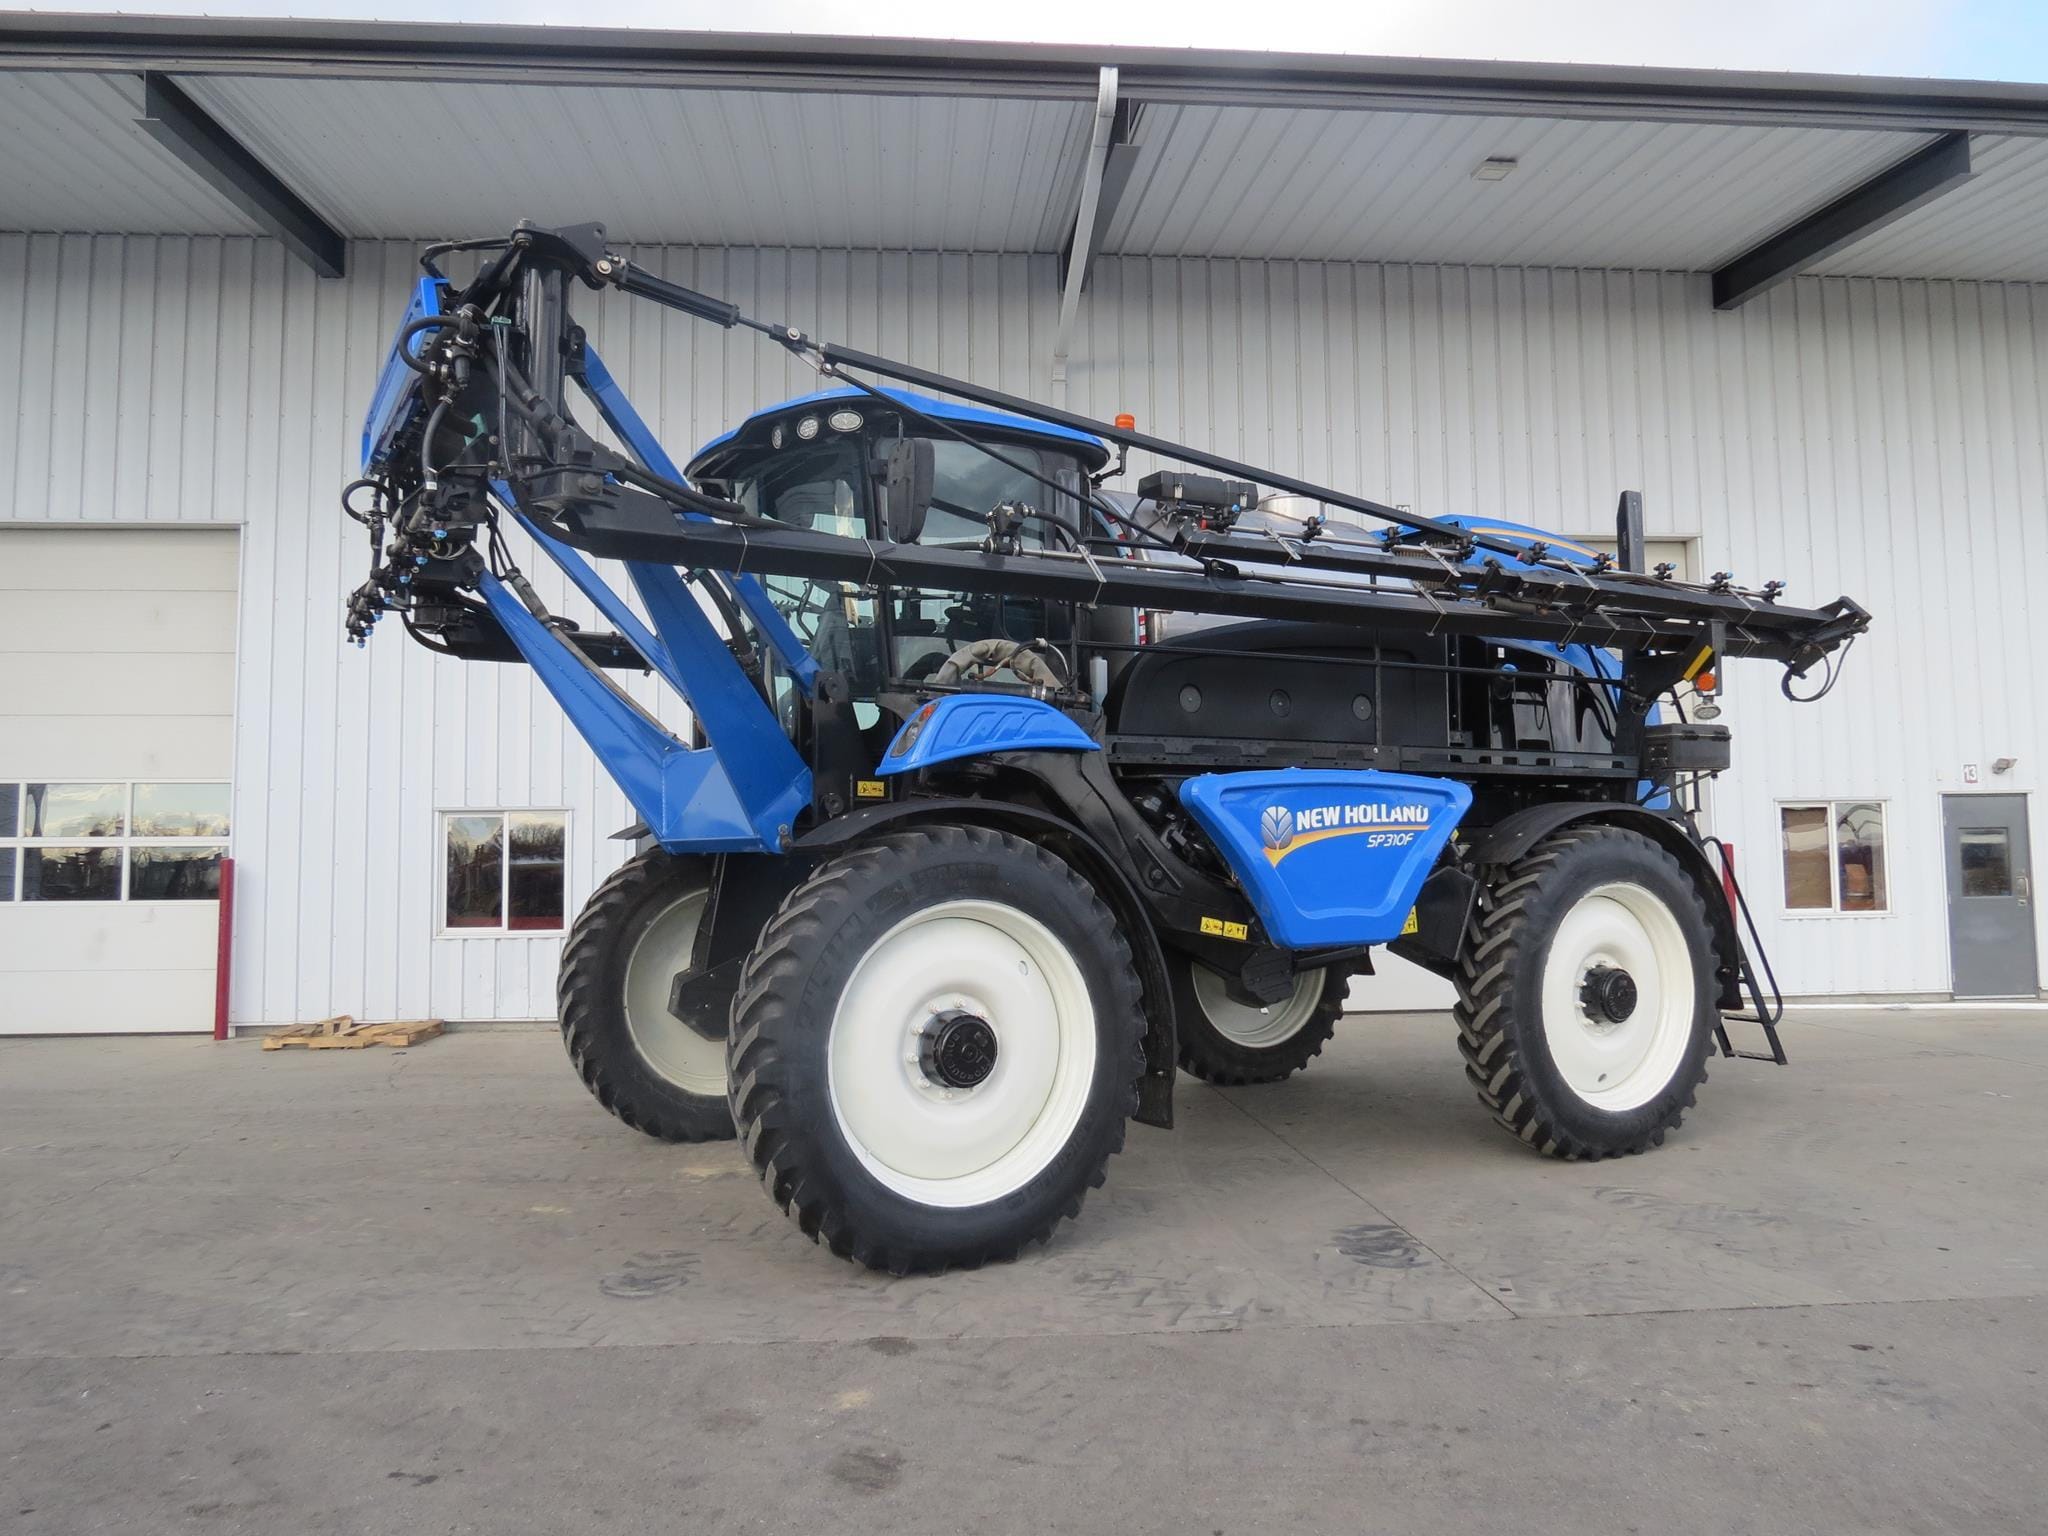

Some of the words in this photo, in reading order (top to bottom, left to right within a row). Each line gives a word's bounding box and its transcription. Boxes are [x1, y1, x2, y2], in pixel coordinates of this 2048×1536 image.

[1964, 765, 1977, 781] 13
[1297, 806, 1340, 831] NEW
[1345, 804, 1429, 824] HOLLAND
[1367, 833, 1414, 848] SP310F
